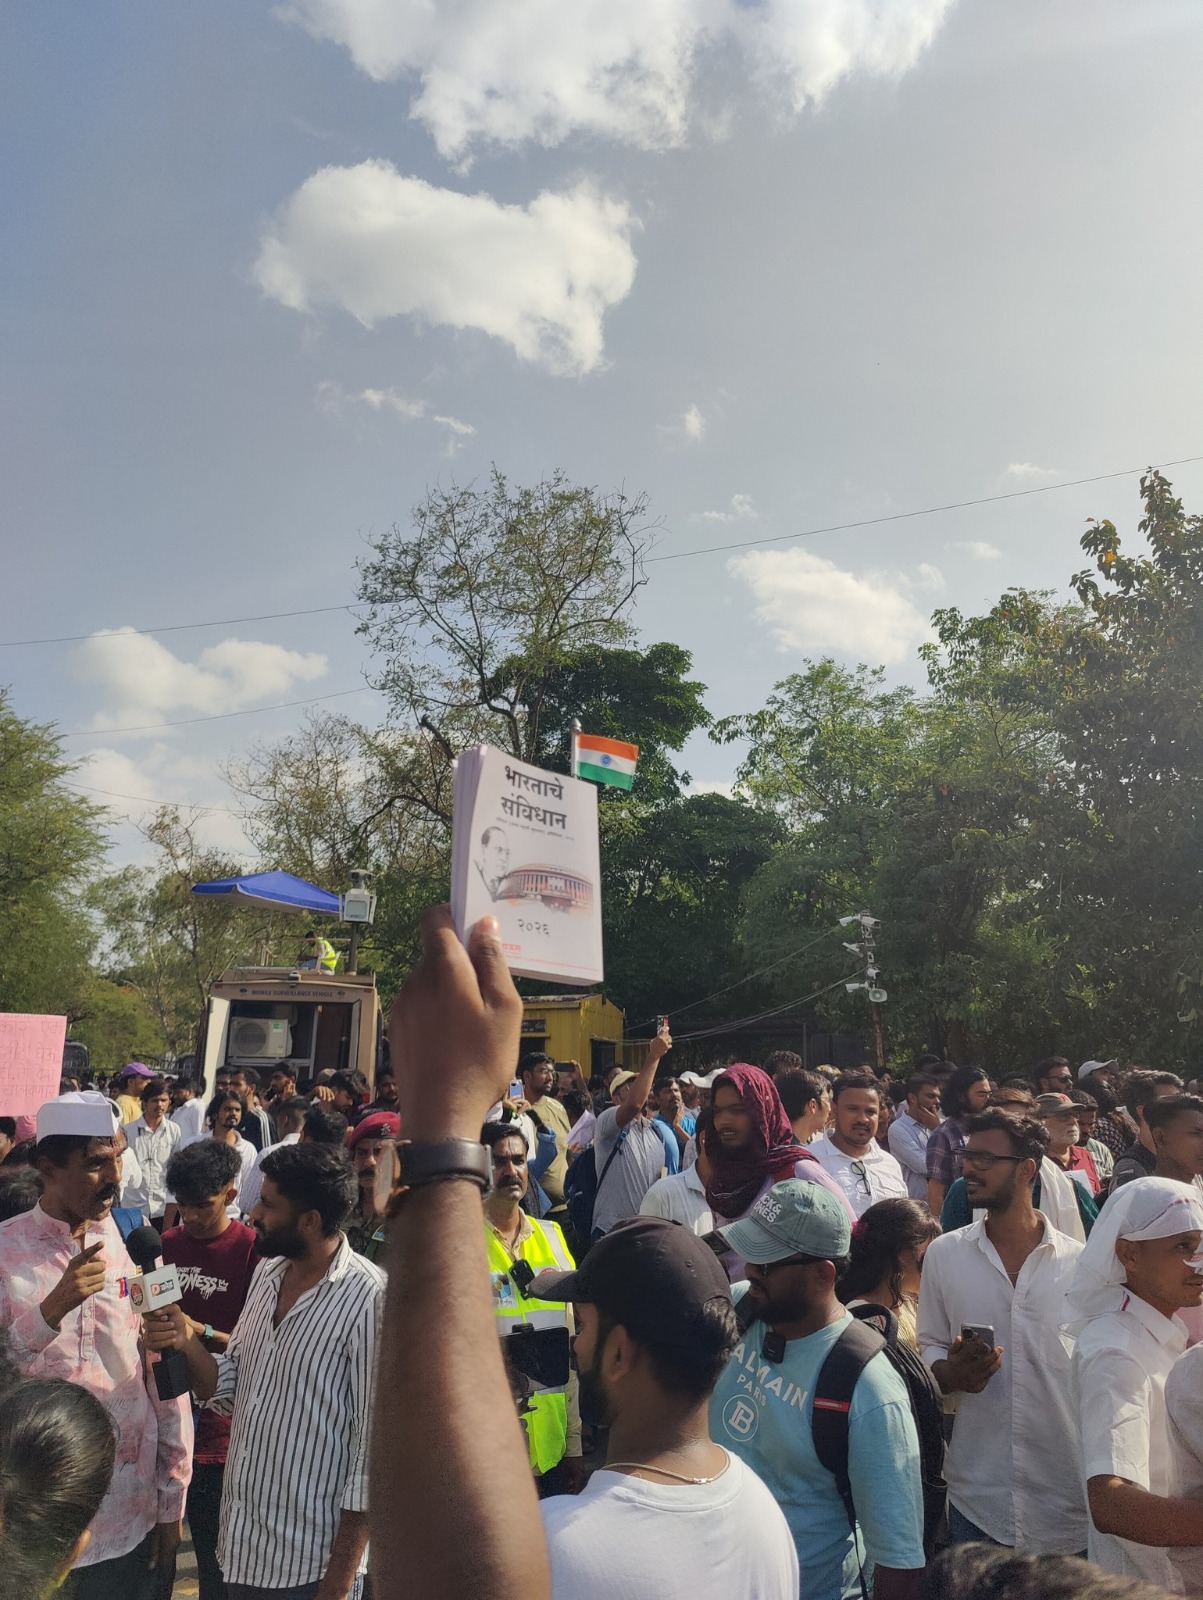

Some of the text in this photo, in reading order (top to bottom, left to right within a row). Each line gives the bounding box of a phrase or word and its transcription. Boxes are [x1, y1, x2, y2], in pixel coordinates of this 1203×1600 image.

[505, 765, 564, 800] भारताचे
[501, 793, 567, 829] संविधान
[517, 918, 551, 938] २०२६
[273, 989, 311, 997] SURVEILLANCE
[753, 1201, 777, 1223] ONES
[177, 1272, 218, 1299] DNESS
[731, 1342, 808, 1411] ALMAIN
[737, 1374, 767, 1406] PARIS
